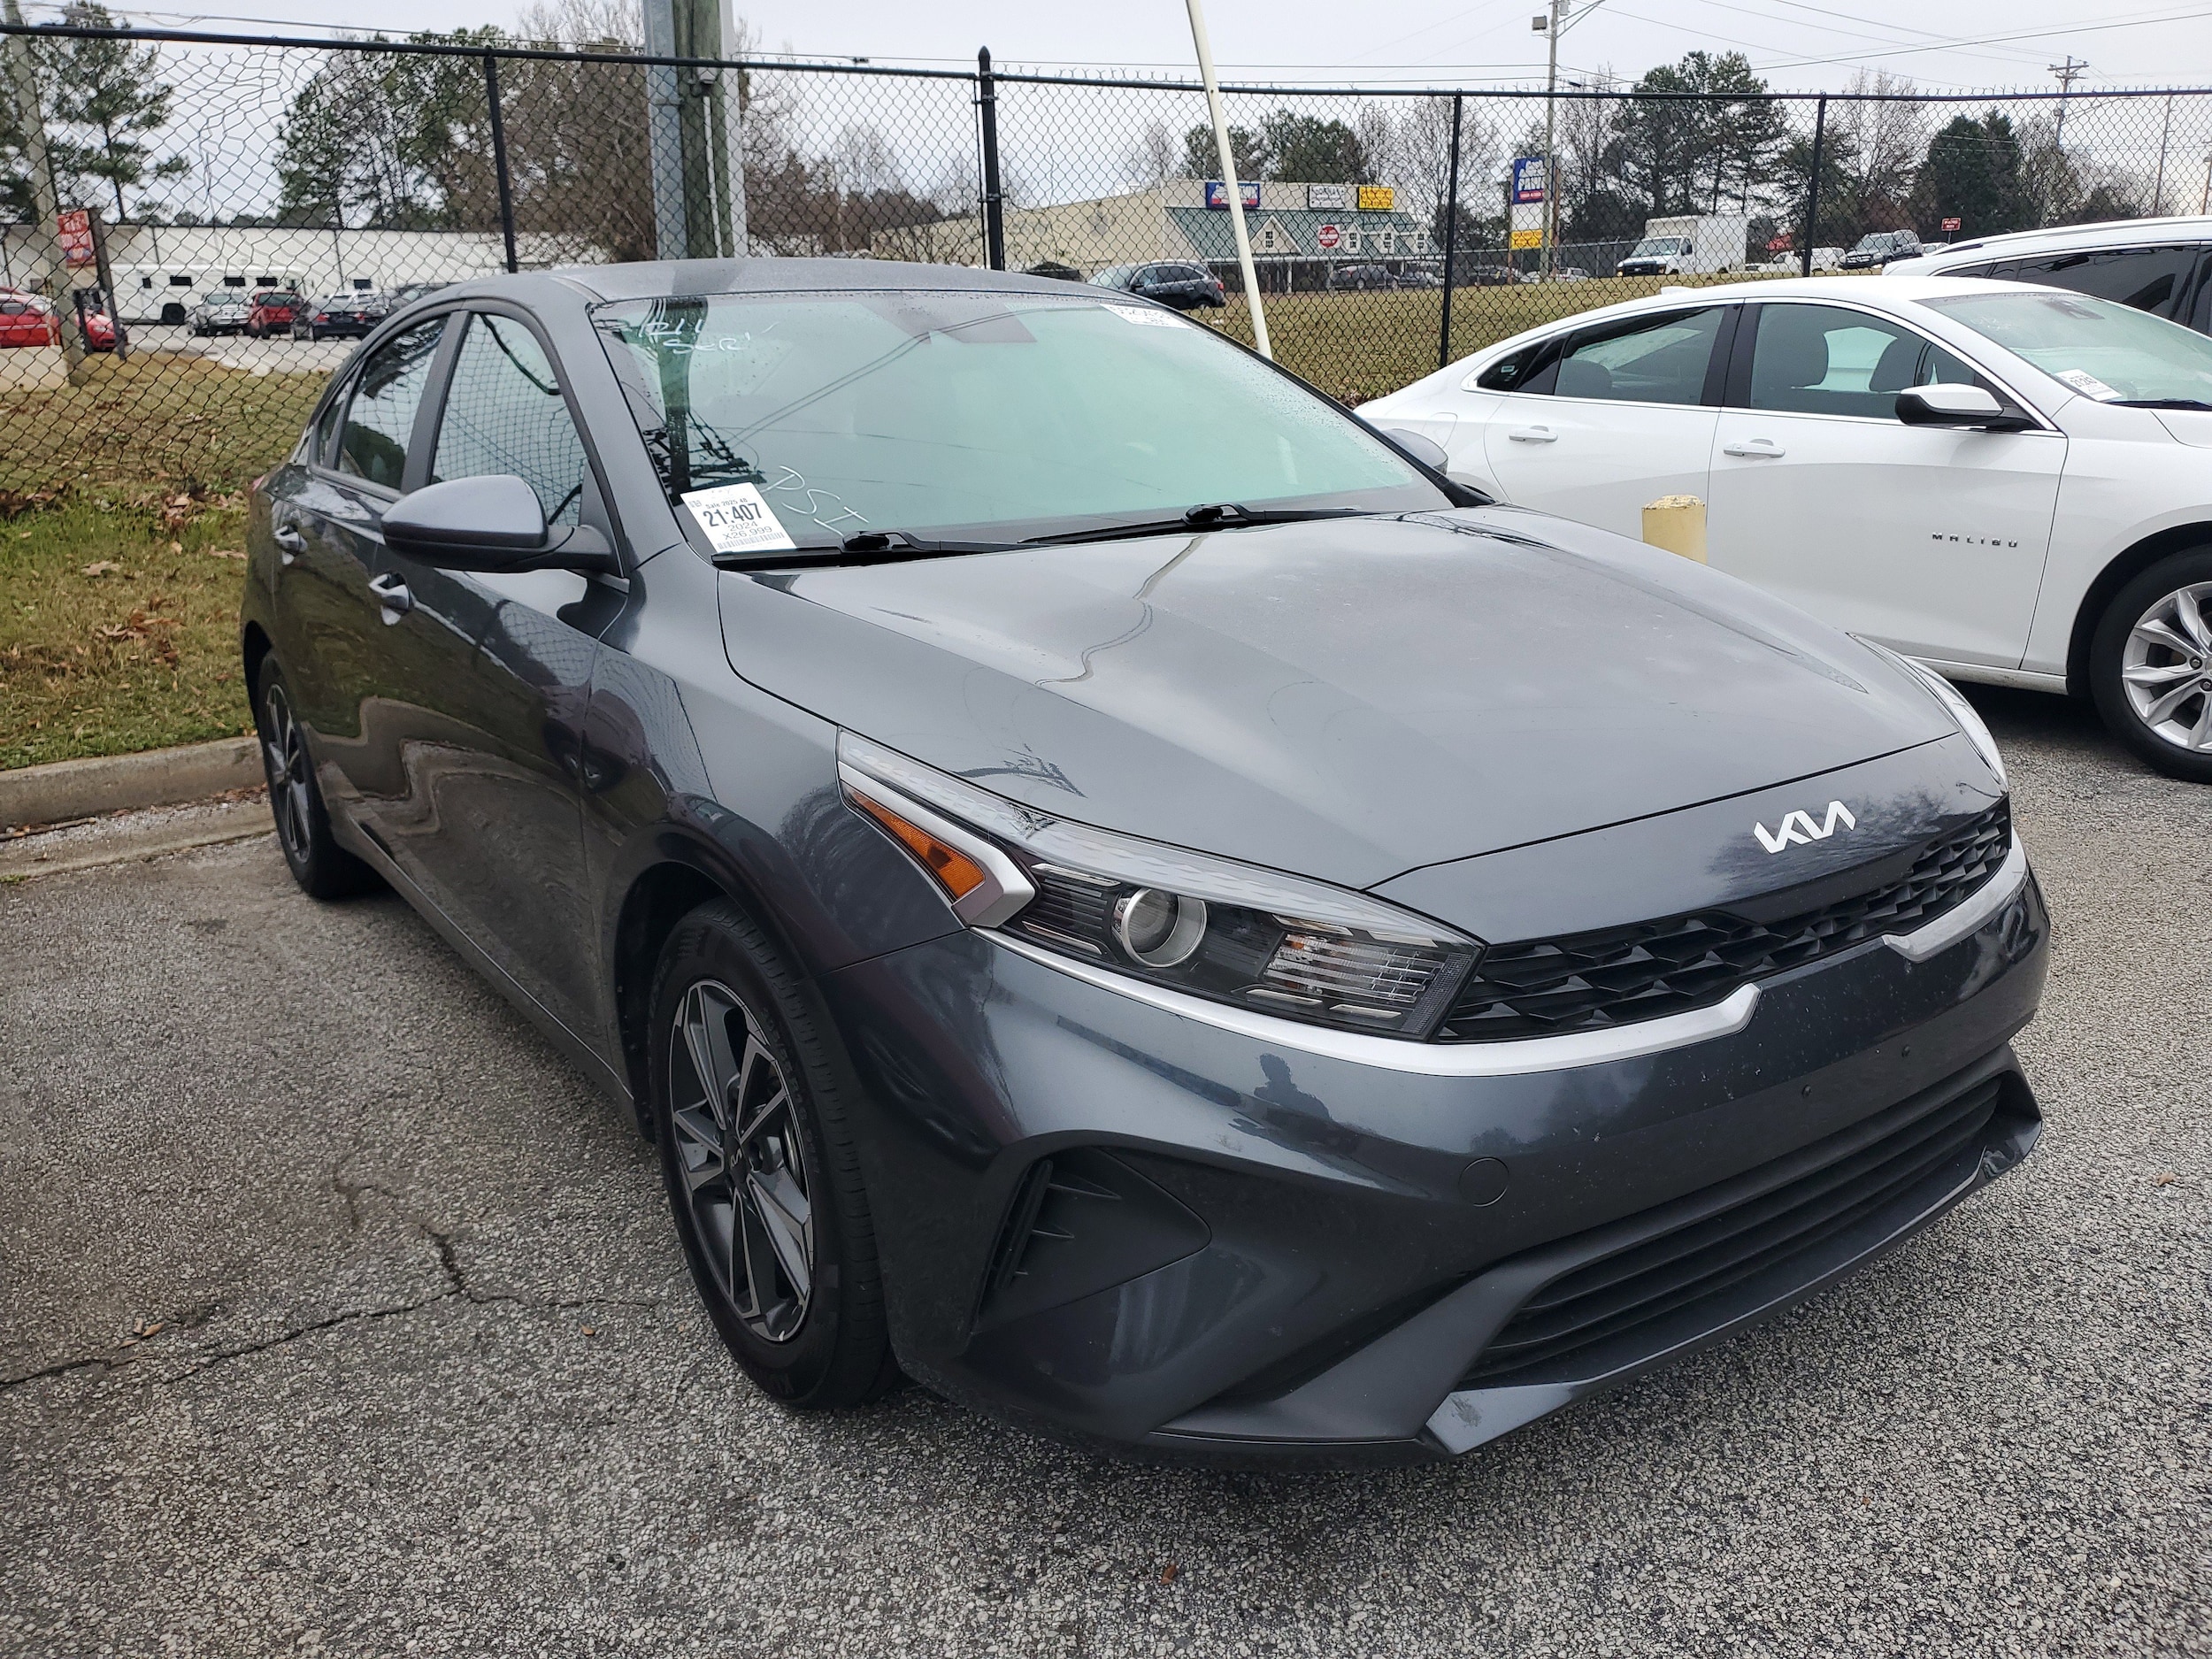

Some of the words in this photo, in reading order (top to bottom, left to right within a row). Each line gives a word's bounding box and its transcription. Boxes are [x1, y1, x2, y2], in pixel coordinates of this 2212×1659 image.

[703, 503, 762, 526] 21:407
[727, 520, 758, 532] 2024
[1932, 532, 2018, 548] MALIBU
[1753, 800, 1856, 855] KIA
